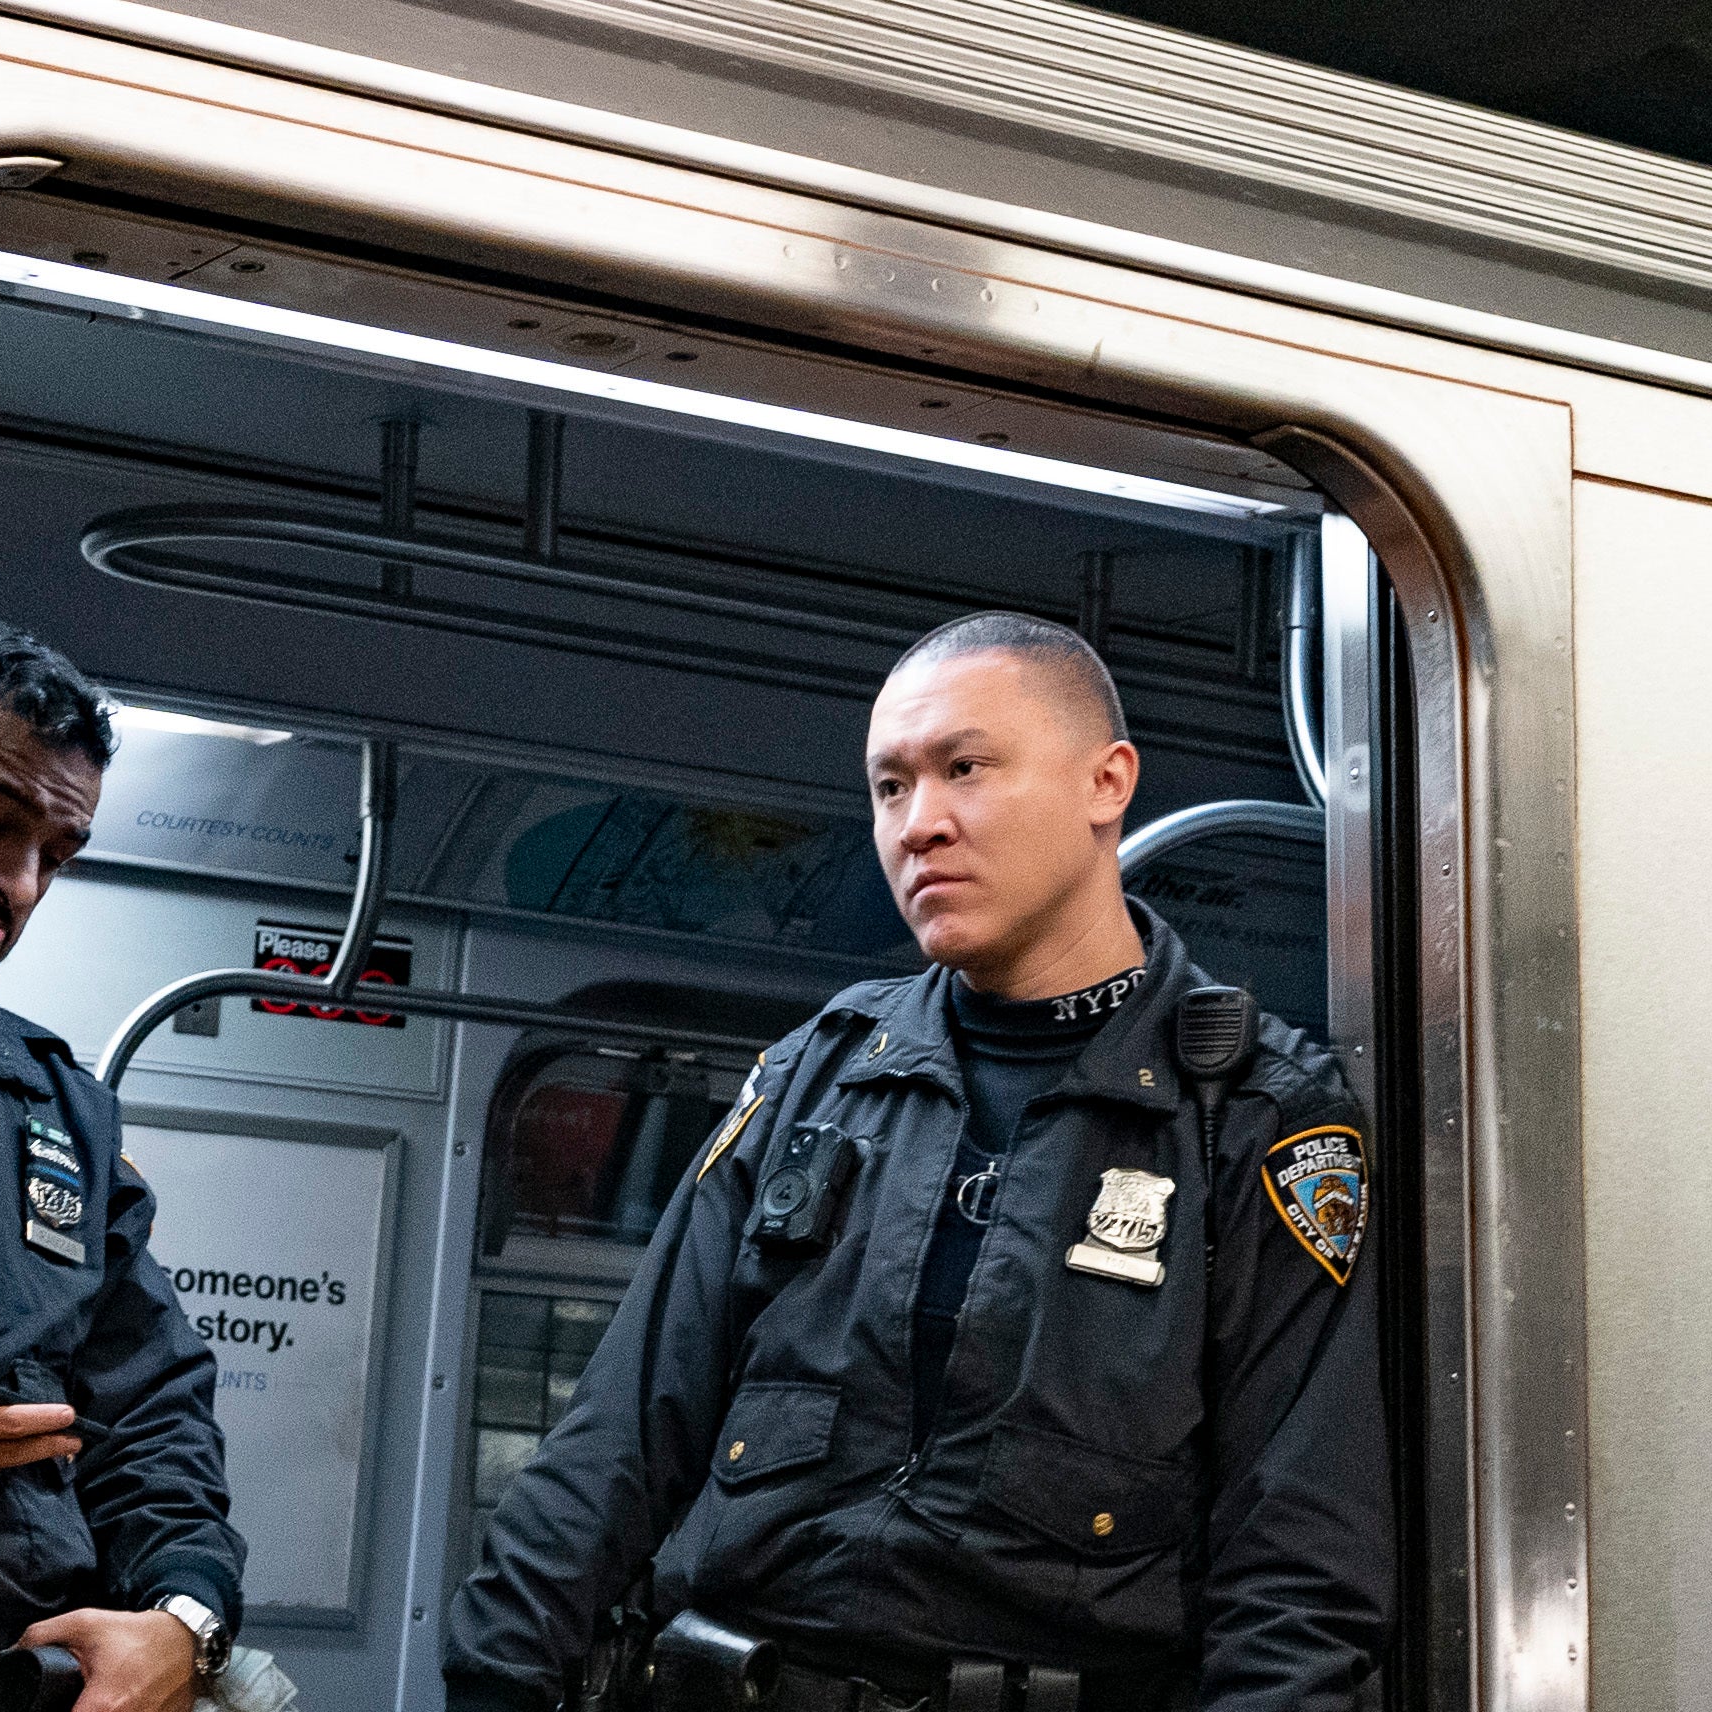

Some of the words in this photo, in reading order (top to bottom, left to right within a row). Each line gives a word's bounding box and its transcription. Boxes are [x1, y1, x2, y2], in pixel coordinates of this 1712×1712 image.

[136, 810, 247, 838] COURTESY
[250, 825, 335, 850] COUNTS
[257, 930, 330, 962] Please
[1137, 1067, 1156, 1088] 2
[1293, 1136, 1350, 1162] POLICE
[1286, 1202, 1318, 1238] CITY
[195, 1309, 294, 1353] story.
